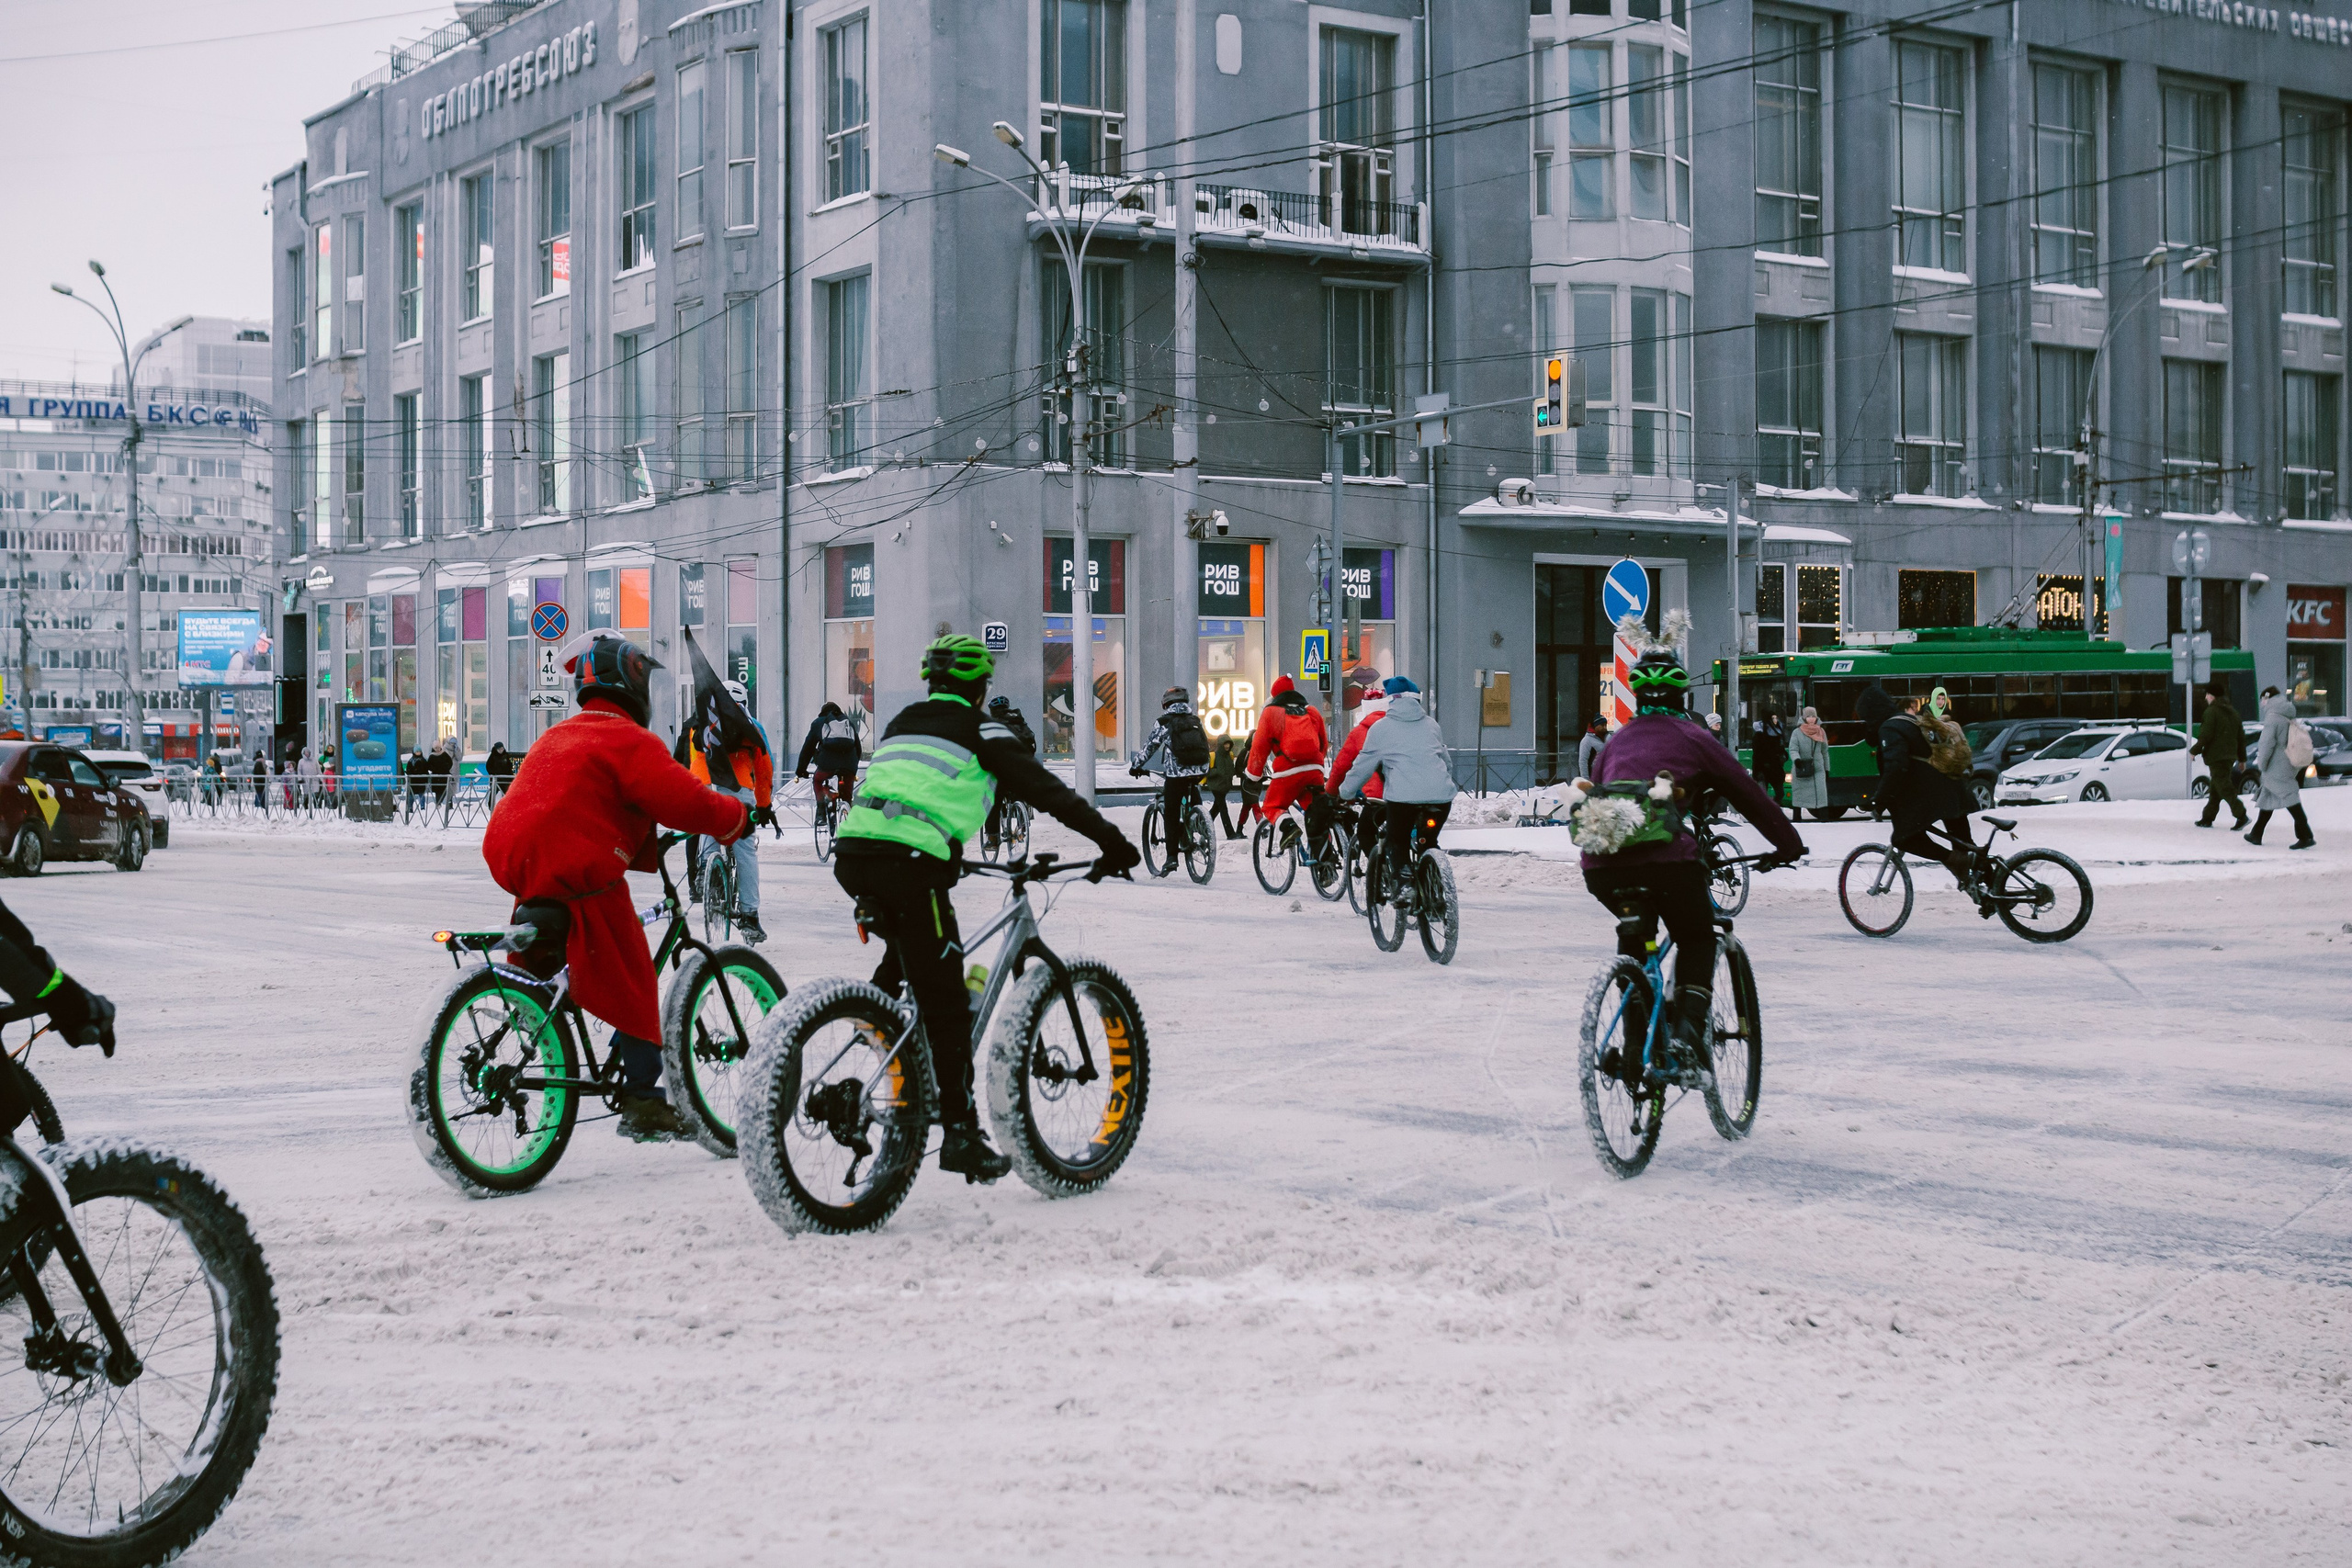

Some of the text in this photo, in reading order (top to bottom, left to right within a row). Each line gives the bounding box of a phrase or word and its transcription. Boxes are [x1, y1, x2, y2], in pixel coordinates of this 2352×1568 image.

[2289, 10, 2352, 46] ОБЩЕС
[422, 19, 596, 139] ОБЛПОТРЕБСОЮЗ
[28, 397, 128, 420] ГРУППА
[147, 403, 208, 426] БКС
[851, 565, 871, 581] РИВ
[1062, 558, 1099, 576] РВ
[1204, 563, 1240, 580] РИВ
[595, 588, 611, 600] РИВ
[851, 581, 871, 597] ГОШ
[1204, 580, 1240, 596] ГОШ
[594, 601, 611, 615] ГОШ
[2286, 599, 2333, 626] KFC
[987, 627, 1006, 640] 29
[1319, 663, 1329, 674] 37
